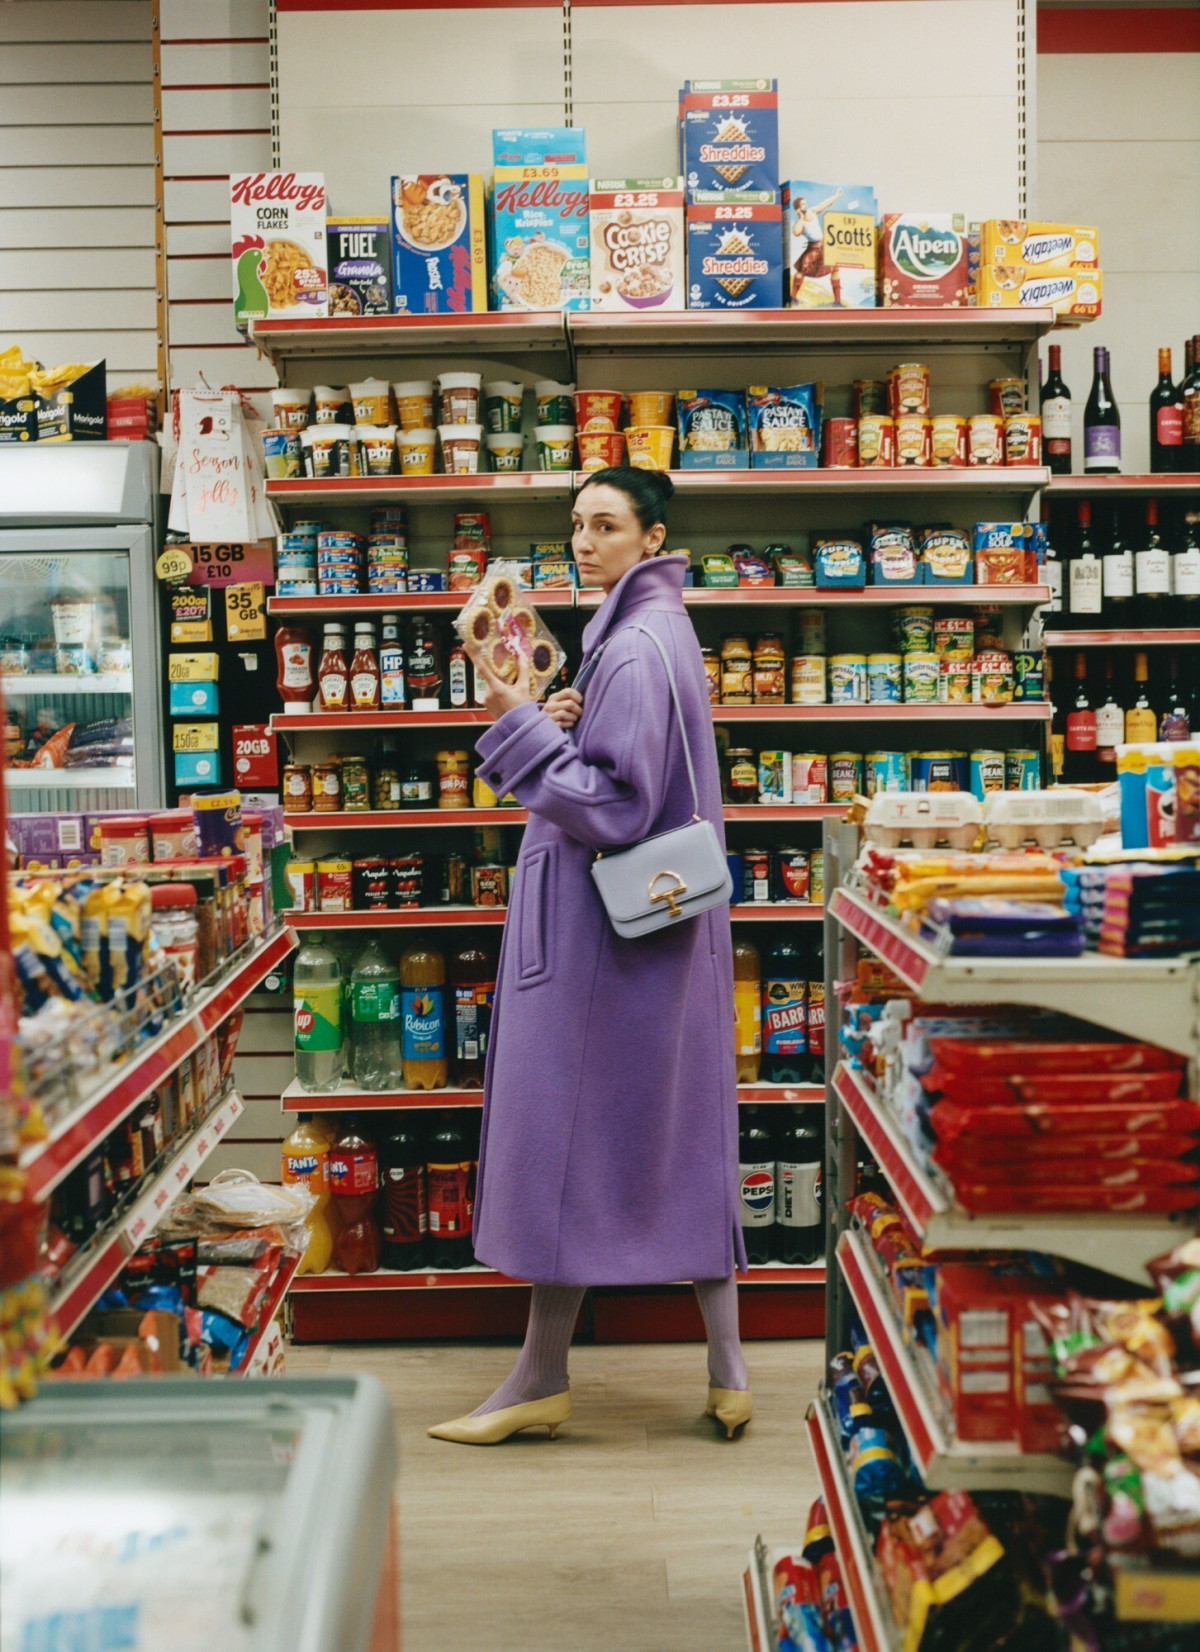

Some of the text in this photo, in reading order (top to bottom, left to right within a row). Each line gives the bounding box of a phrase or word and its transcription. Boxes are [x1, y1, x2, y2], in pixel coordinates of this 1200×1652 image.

[712, 95, 750, 107] £3.25
[700, 145, 765, 162] Shreddies
[522, 171, 560, 181] £3.69
[614, 194, 658, 207] £3.25
[257, 208, 290, 220] CORN
[715, 207, 753, 219] £3.25
[257, 220, 290, 231] FLAKES
[827, 224, 873, 247] Scott's
[340, 233, 378, 258] FUEL
[474, 230, 484, 265] £3.69
[894, 230, 957, 260] Alpen
[1022, 237, 1072, 259] Weetabix
[338, 261, 385, 277] Granola
[702, 256, 768, 275] Shreddies
[1019, 280, 1073, 304] Weetabix
[691, 421, 735, 432] SAUCE
[763, 417, 806, 428] SAUCE
[189, 448, 241, 474] Season
[367, 448, 394, 461] POT
[196, 479, 238, 513] jolly
[191, 543, 245, 564] 15 GB
[536, 544, 565, 554] SPAM
[162, 560, 188, 575] 99p
[207, 565, 232, 579] £10
[539, 564, 569, 575] SPAM
[228, 592, 252, 610] 35
[239, 609, 259, 621] GB
[383, 656, 403, 671] HP
[174, 733, 200, 749] 150GB
[235, 739, 271, 755] 20GB
[833, 768, 856, 778] BEANZ
[296, 1013, 312, 1030] up
[406, 1014, 441, 1031] Rubicon
[772, 1006, 806, 1030] BARR
[288, 1156, 319, 1171] FANTA
[784, 1187, 793, 1219] DIET
